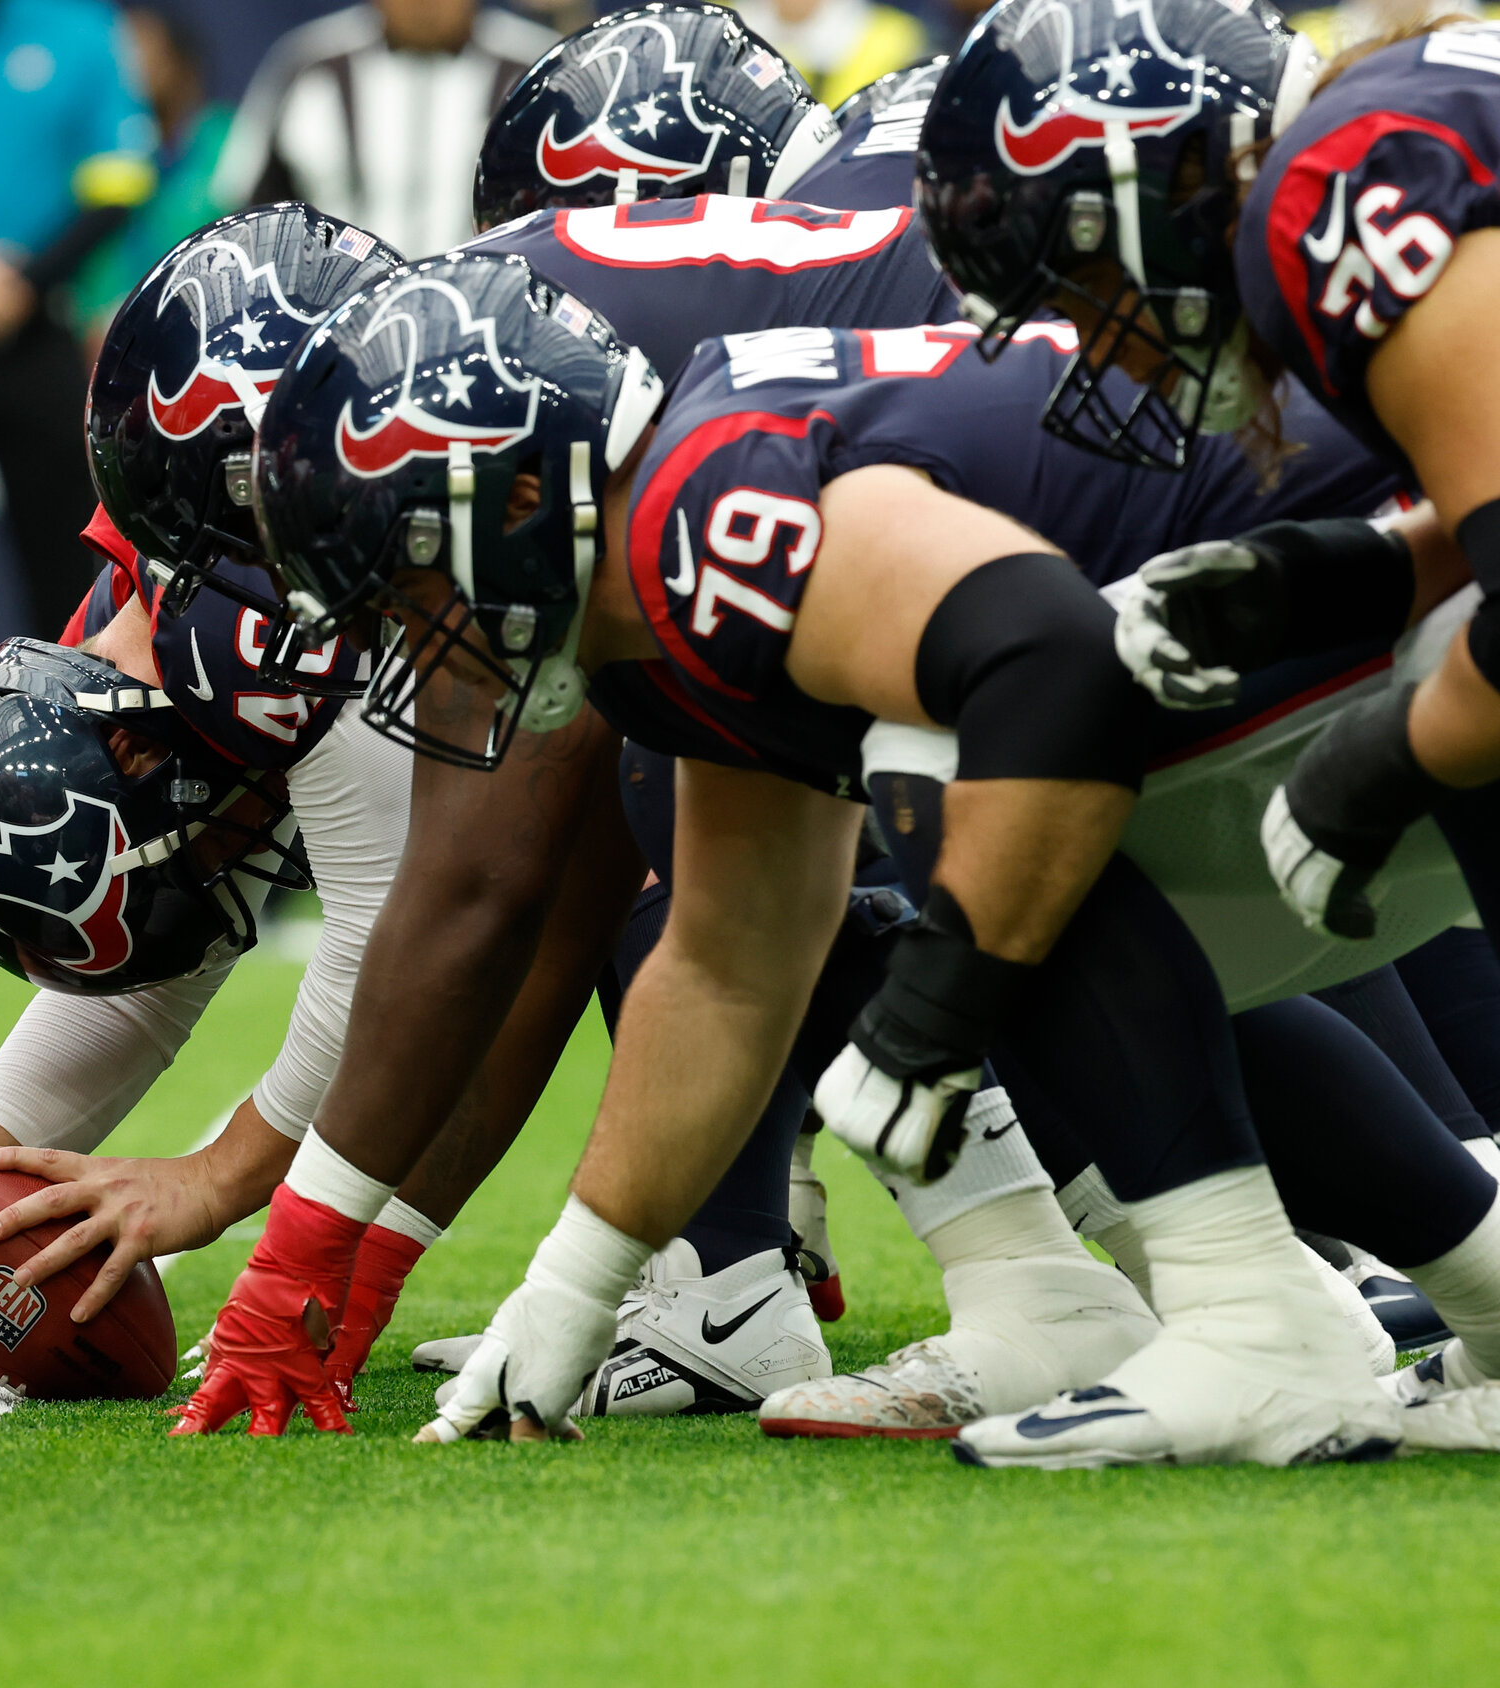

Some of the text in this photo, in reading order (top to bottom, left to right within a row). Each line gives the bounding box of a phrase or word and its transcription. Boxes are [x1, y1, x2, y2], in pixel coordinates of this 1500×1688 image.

[1316, 183, 1456, 339] 76
[689, 485, 824, 639] 79
[614, 1366, 679, 1399] ALPHA
